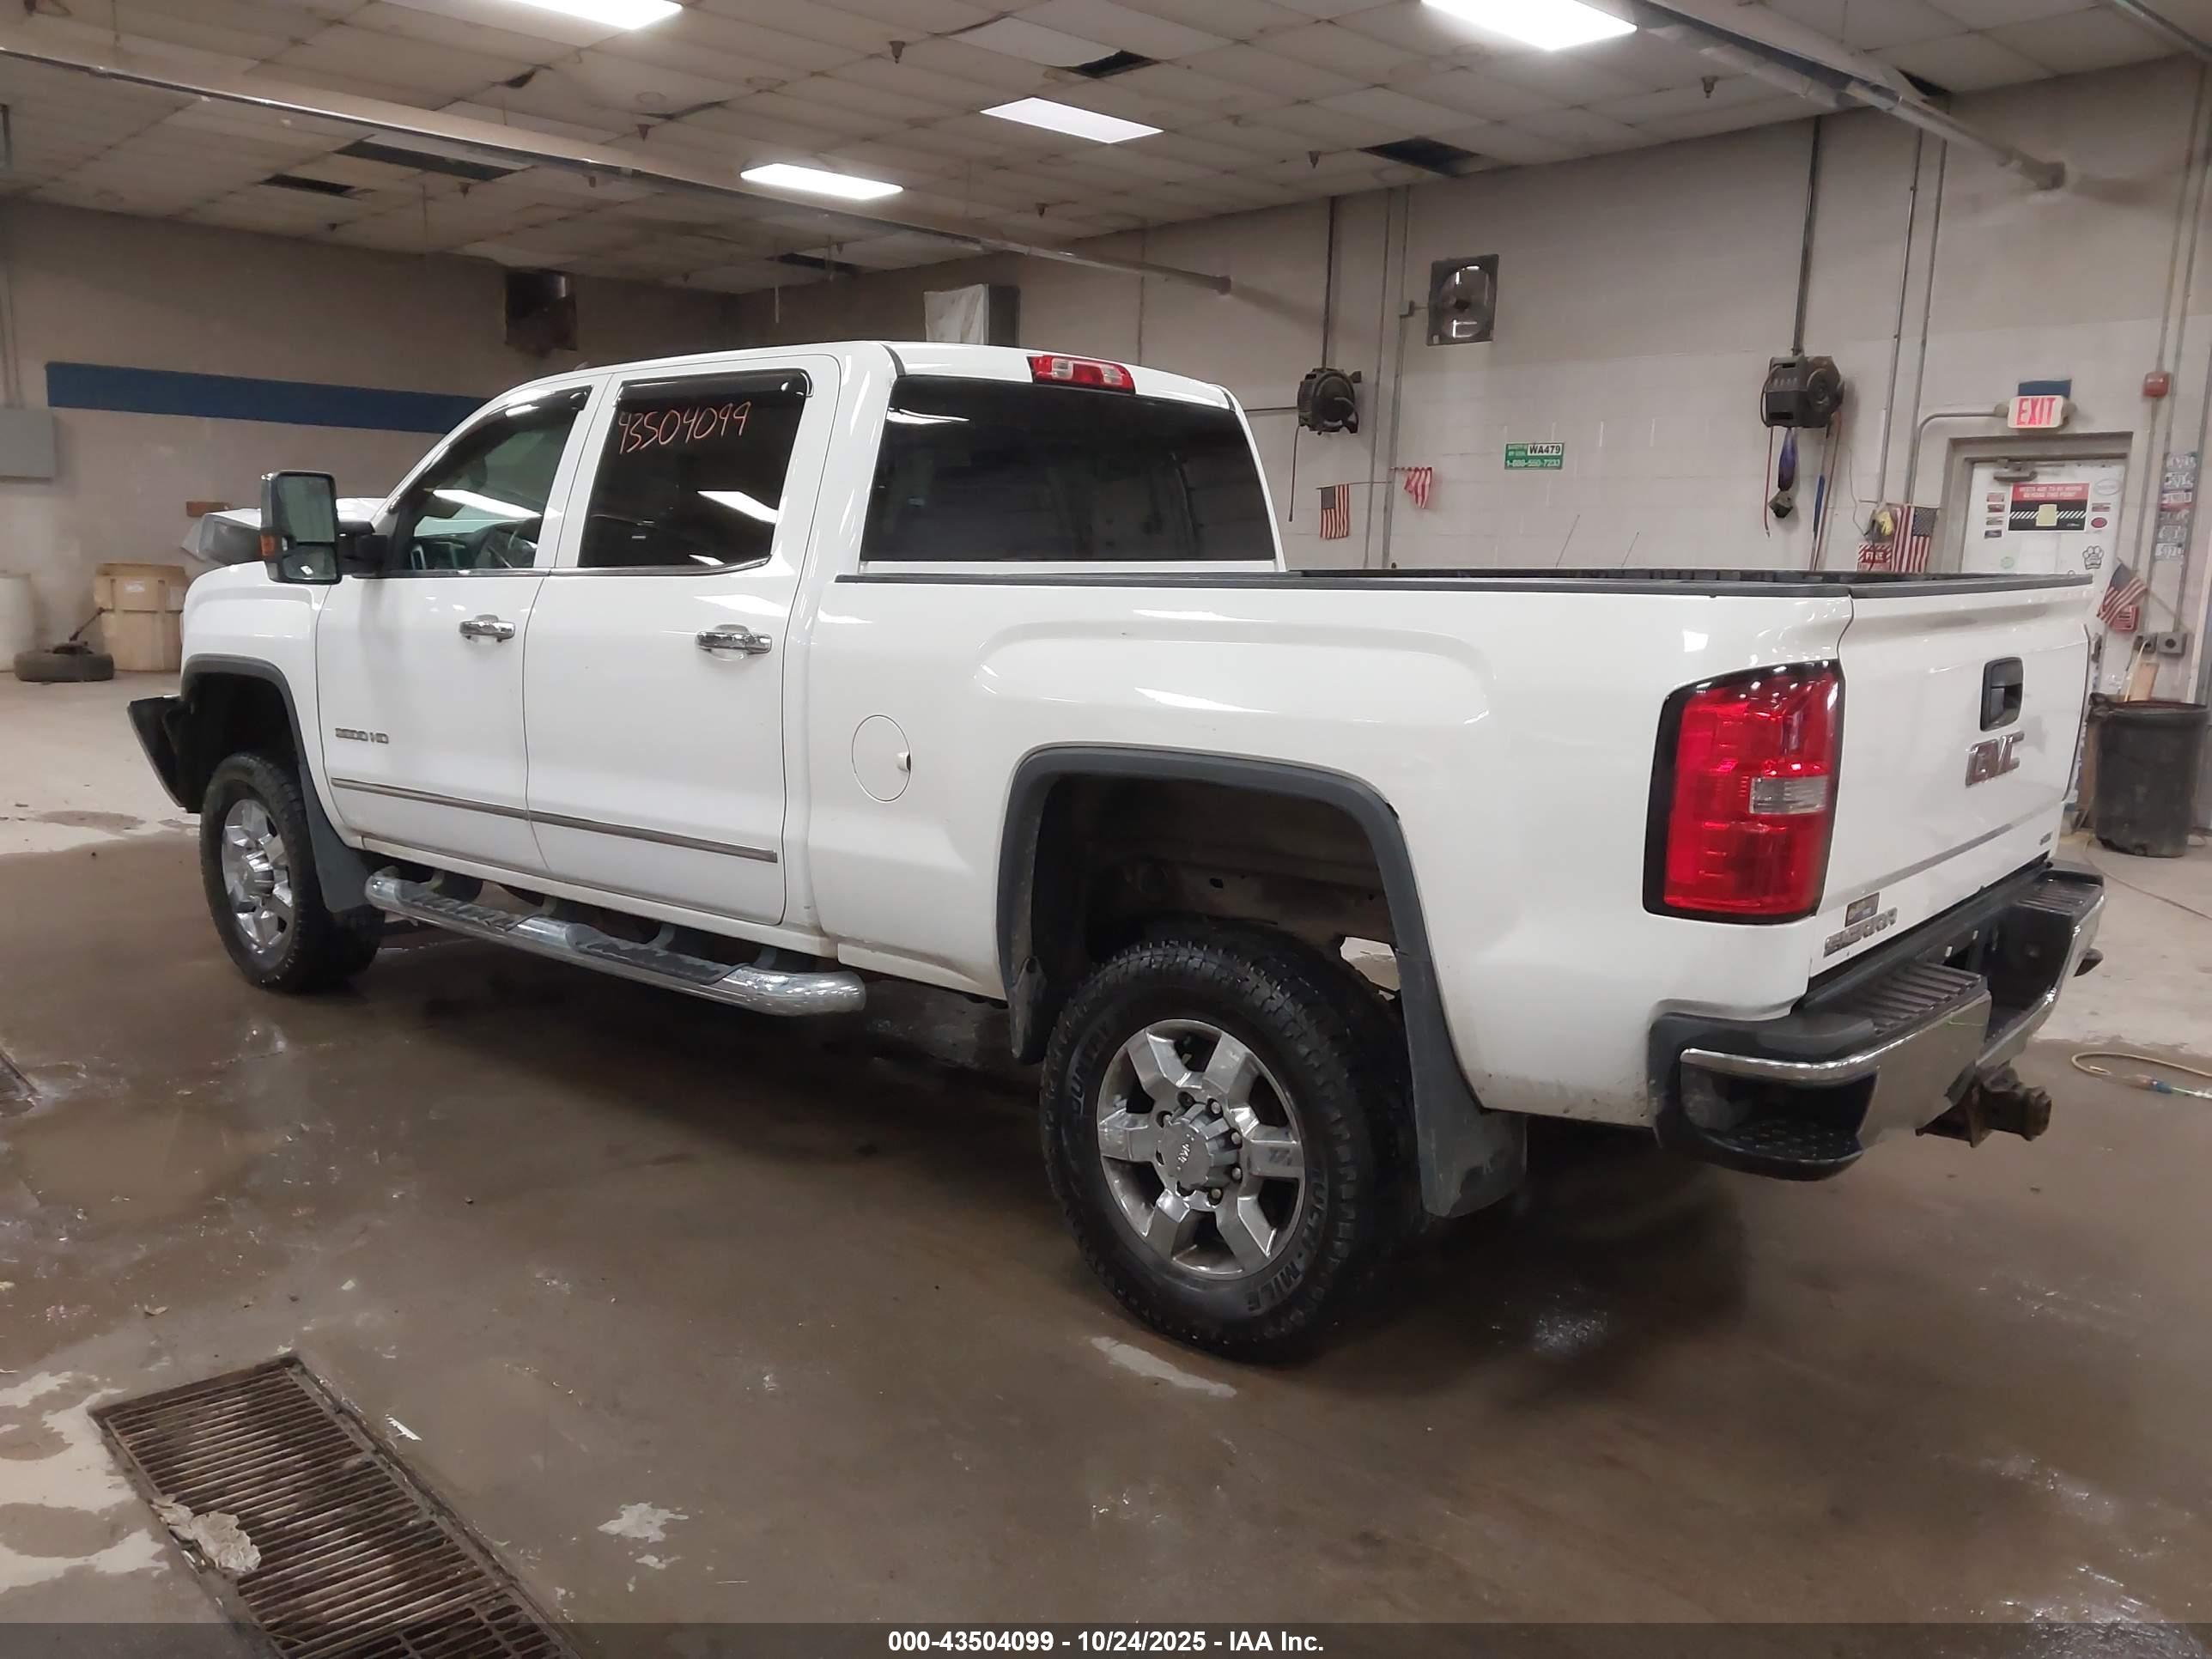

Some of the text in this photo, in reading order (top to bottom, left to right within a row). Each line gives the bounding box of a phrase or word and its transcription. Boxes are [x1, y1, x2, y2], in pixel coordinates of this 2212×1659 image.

[2016, 398, 2056, 426] EXIT
[618, 401, 751, 454] 43504099
[1529, 445, 1561, 454] WA479
